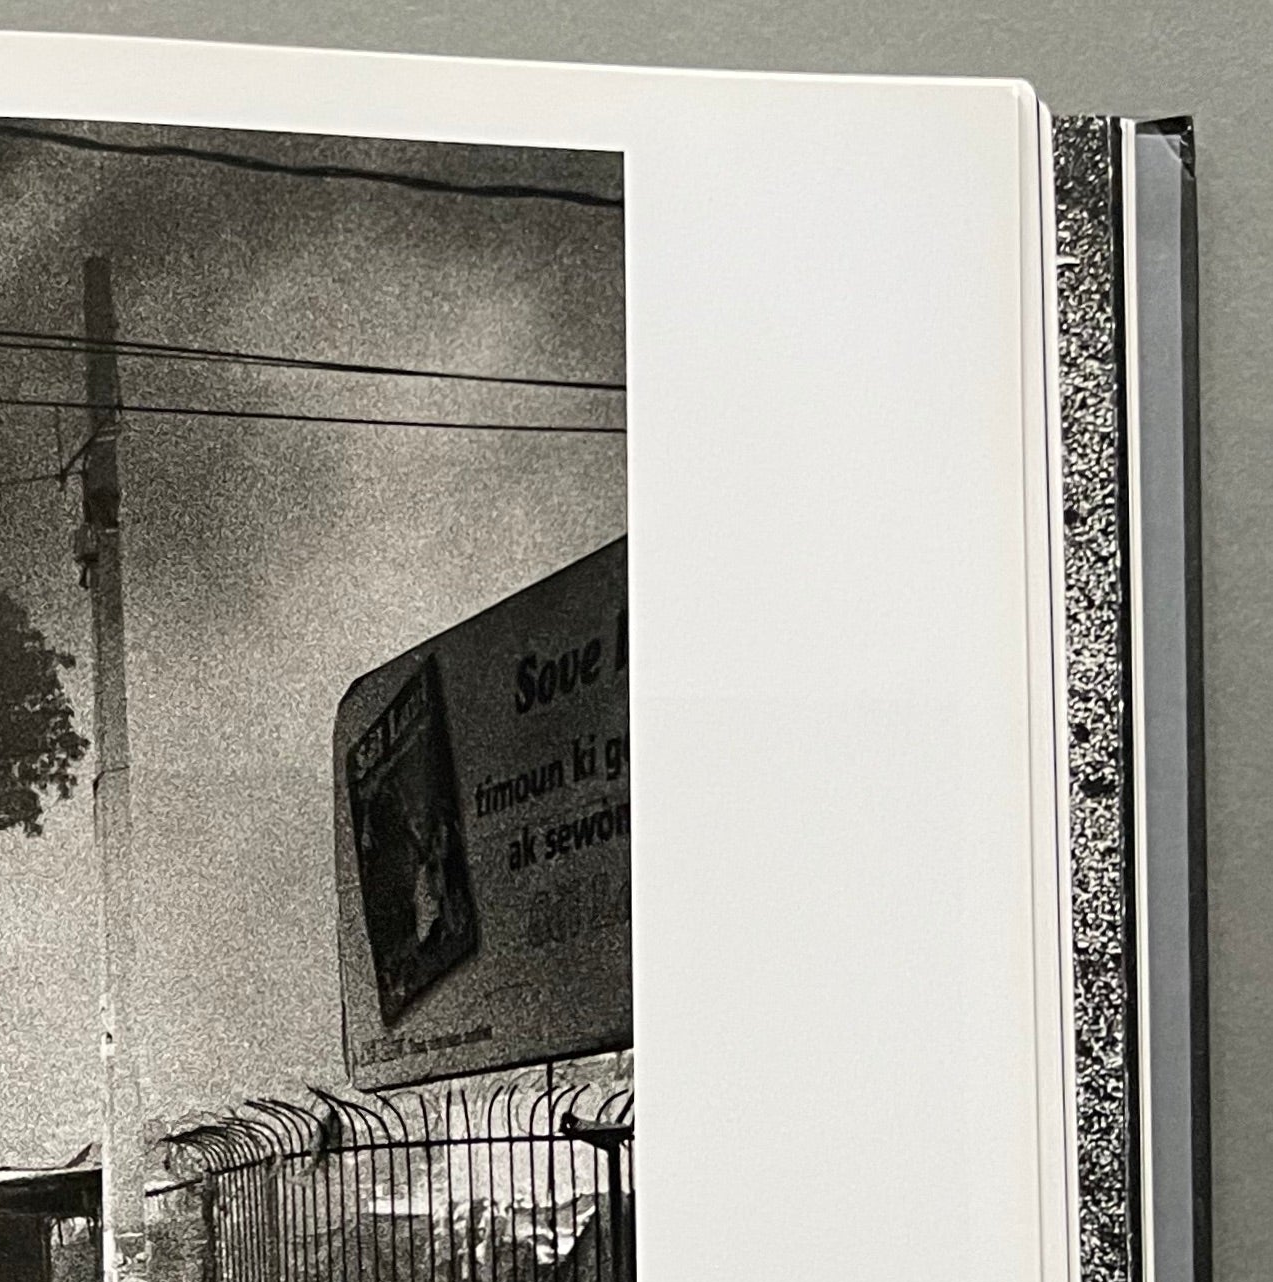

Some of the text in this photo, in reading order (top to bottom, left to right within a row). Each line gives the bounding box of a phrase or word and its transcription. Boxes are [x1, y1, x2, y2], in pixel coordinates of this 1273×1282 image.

[475, 760, 563, 818] timoun
[574, 733, 595, 783] ki
[509, 829, 537, 872] ak
